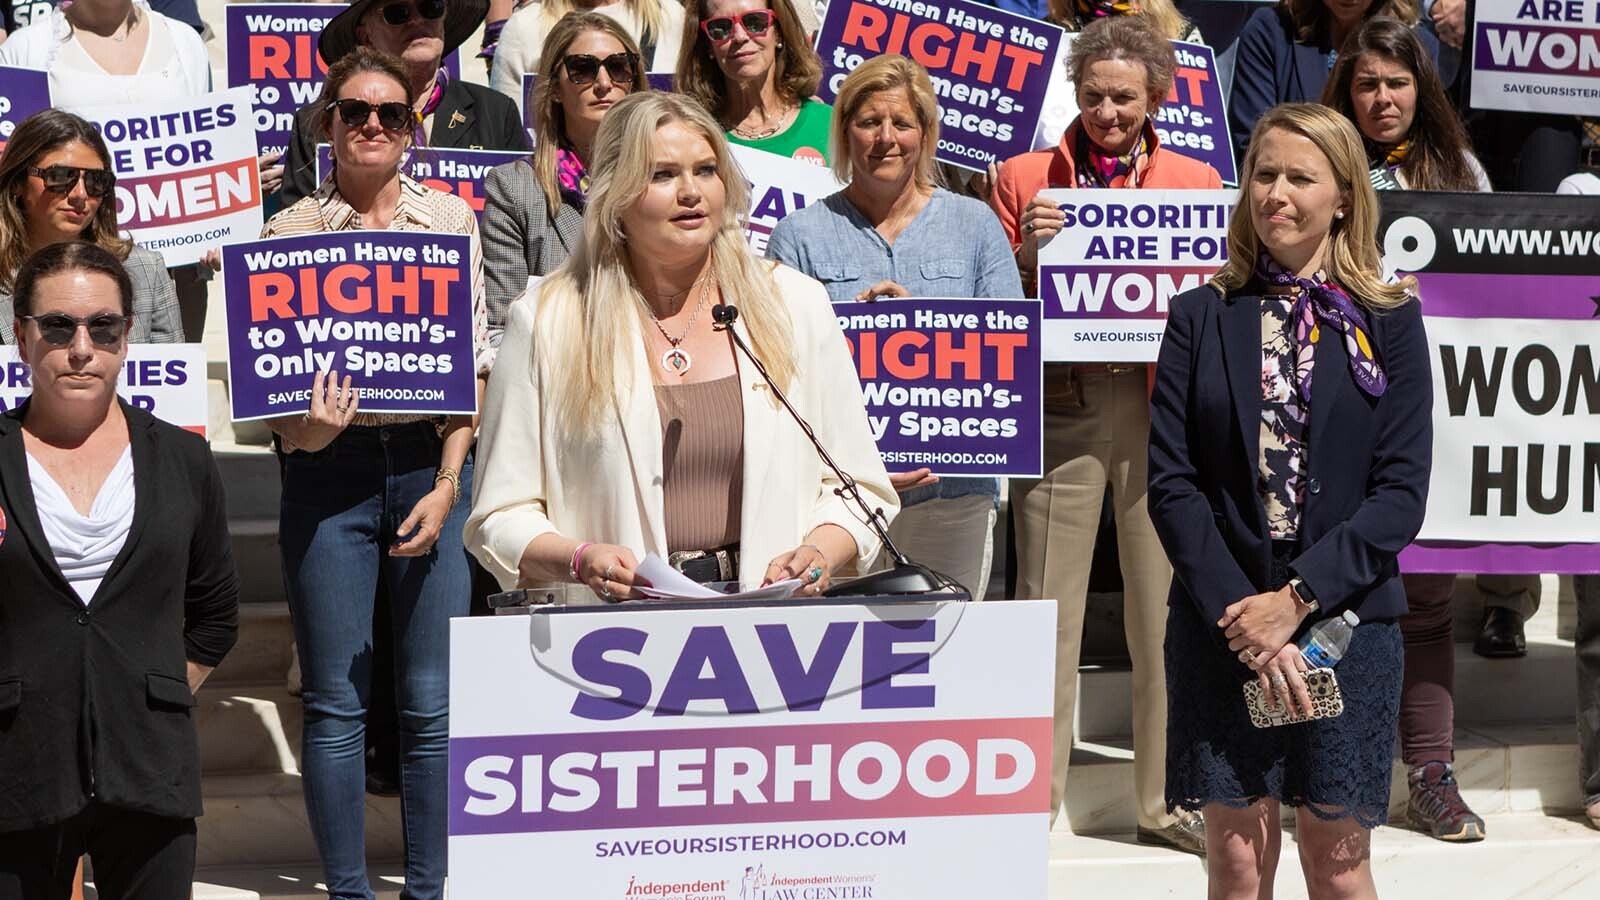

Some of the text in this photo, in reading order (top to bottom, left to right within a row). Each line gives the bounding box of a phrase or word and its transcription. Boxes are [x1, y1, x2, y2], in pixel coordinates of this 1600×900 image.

[245, 15, 332, 33] Wome
[1516, 0, 1585, 23] ARE
[945, 7, 1005, 38] Have
[1010, 26, 1049, 50] the
[249, 35, 329, 79] RI
[841, 1, 1044, 92] RIGHT
[1174, 49, 1208, 69] the
[1503, 83, 1600, 99] SAVEOURSISTER
[143, 139, 215, 171] FOR
[1058, 203, 1234, 229] SORORITI
[244, 242, 460, 271] Women Have the
[1084, 235, 1159, 260] ARE
[248, 263, 460, 322] RIGHT
[1051, 272, 1217, 313] WOM
[837, 310, 1029, 331] omen Have the
[248, 327, 286, 350] to
[254, 345, 454, 379] Only Spaces
[844, 330, 1028, 381] IGHT
[899, 411, 1018, 442] Spaces
[569, 619, 937, 721] SAVE
[463, 737, 1037, 815] SISTERHOOD
[595, 828, 907, 858] SAVEOURSISTERHOOD.COM
[803, 885, 873, 900] CENTER
